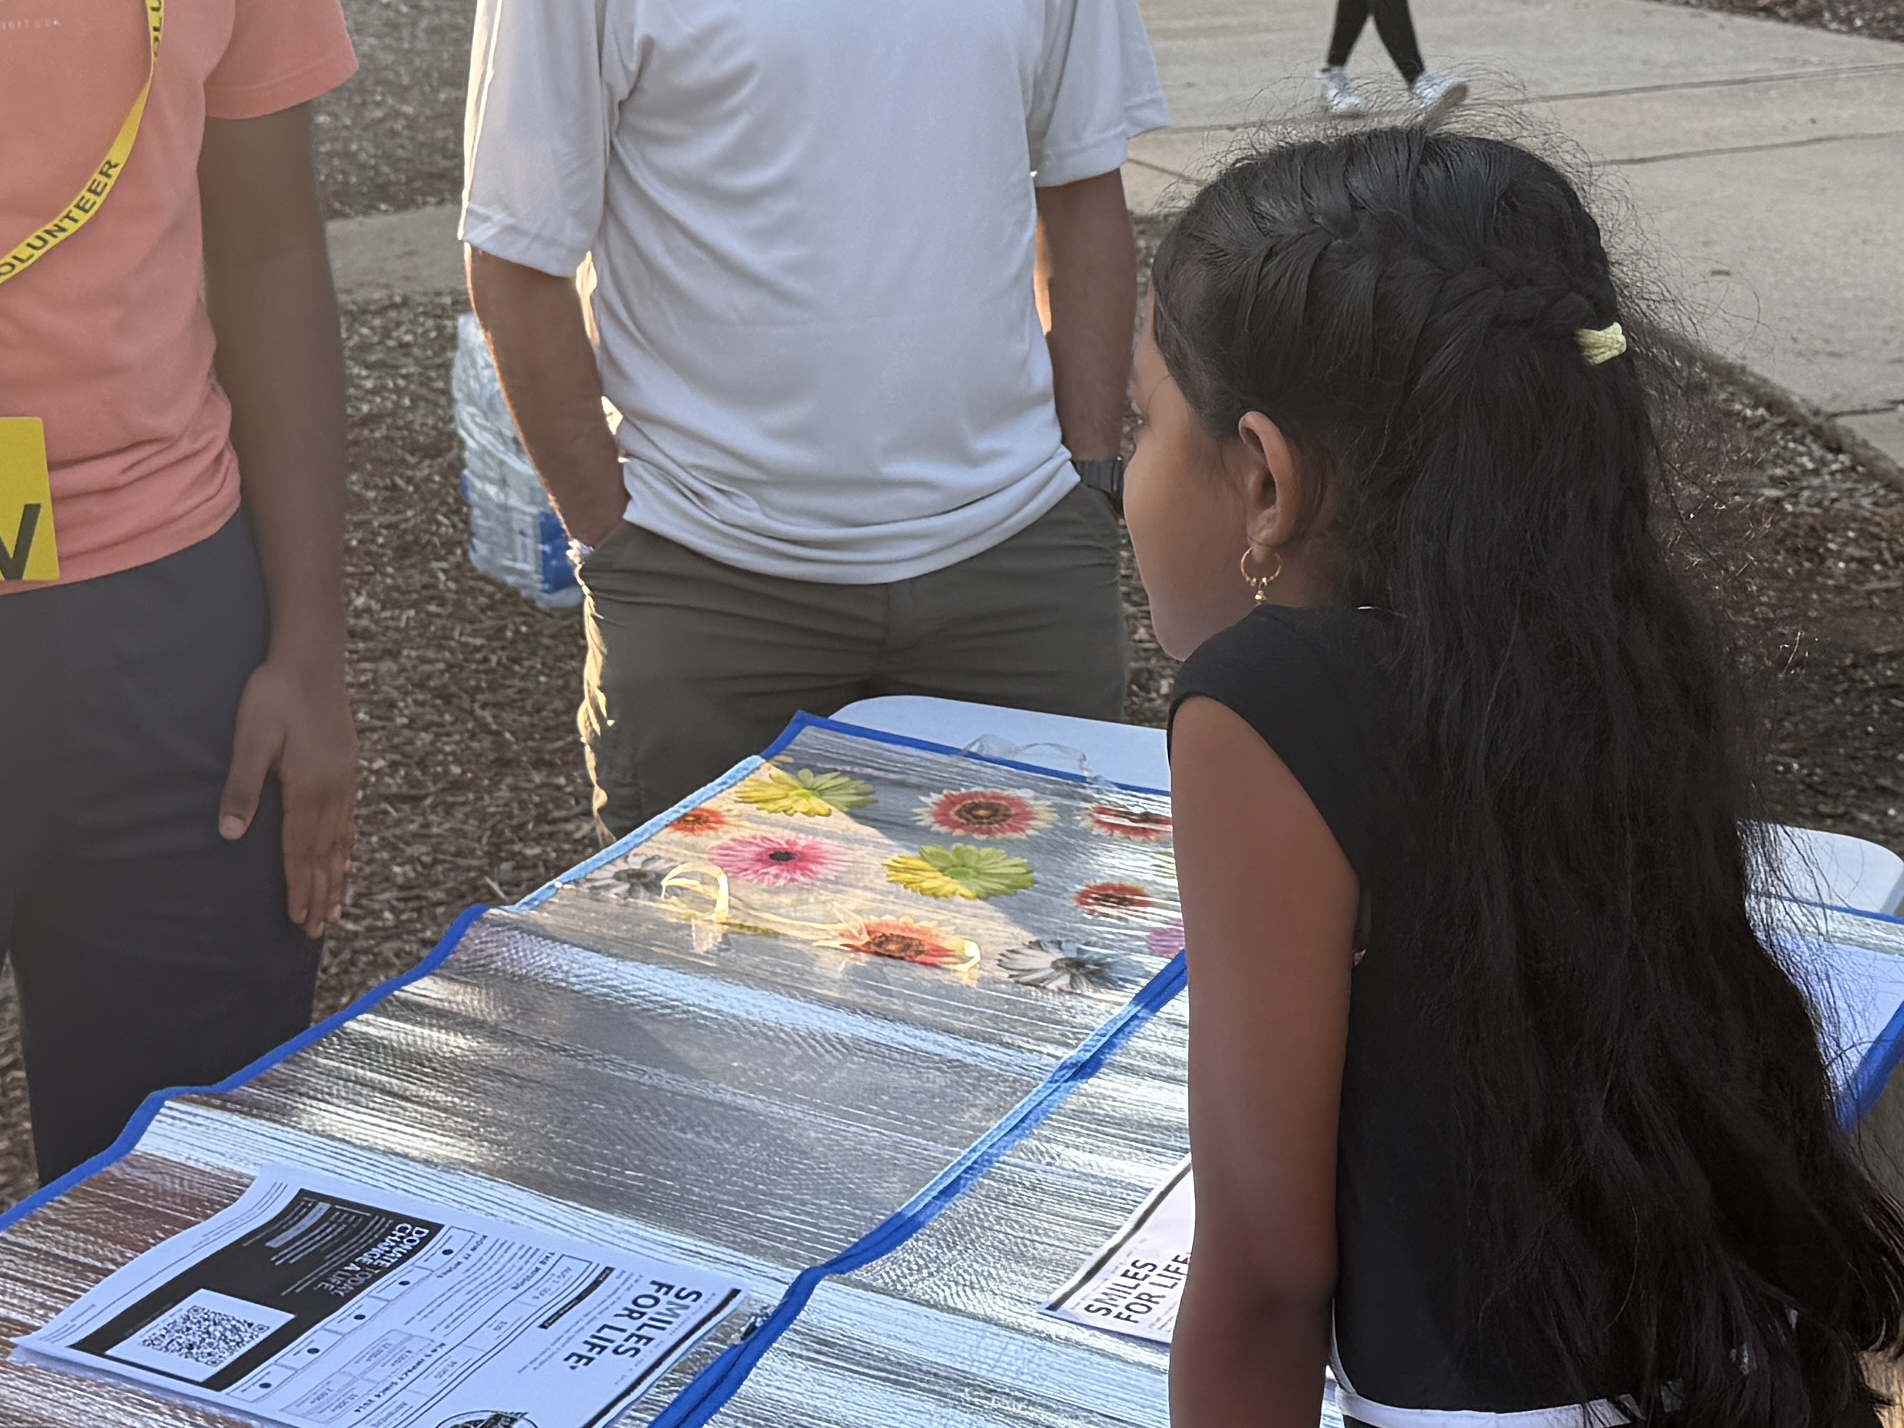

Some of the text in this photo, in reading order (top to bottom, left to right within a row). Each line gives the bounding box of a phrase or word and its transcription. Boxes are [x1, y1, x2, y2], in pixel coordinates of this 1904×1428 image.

[612, 1279, 675, 1320] FOR
[1085, 1259, 1158, 1319] SMILES
[1113, 1291, 1166, 1324] FOR
[611, 1286, 702, 1358] SMILES
[563, 1323, 627, 1366] LIFE
